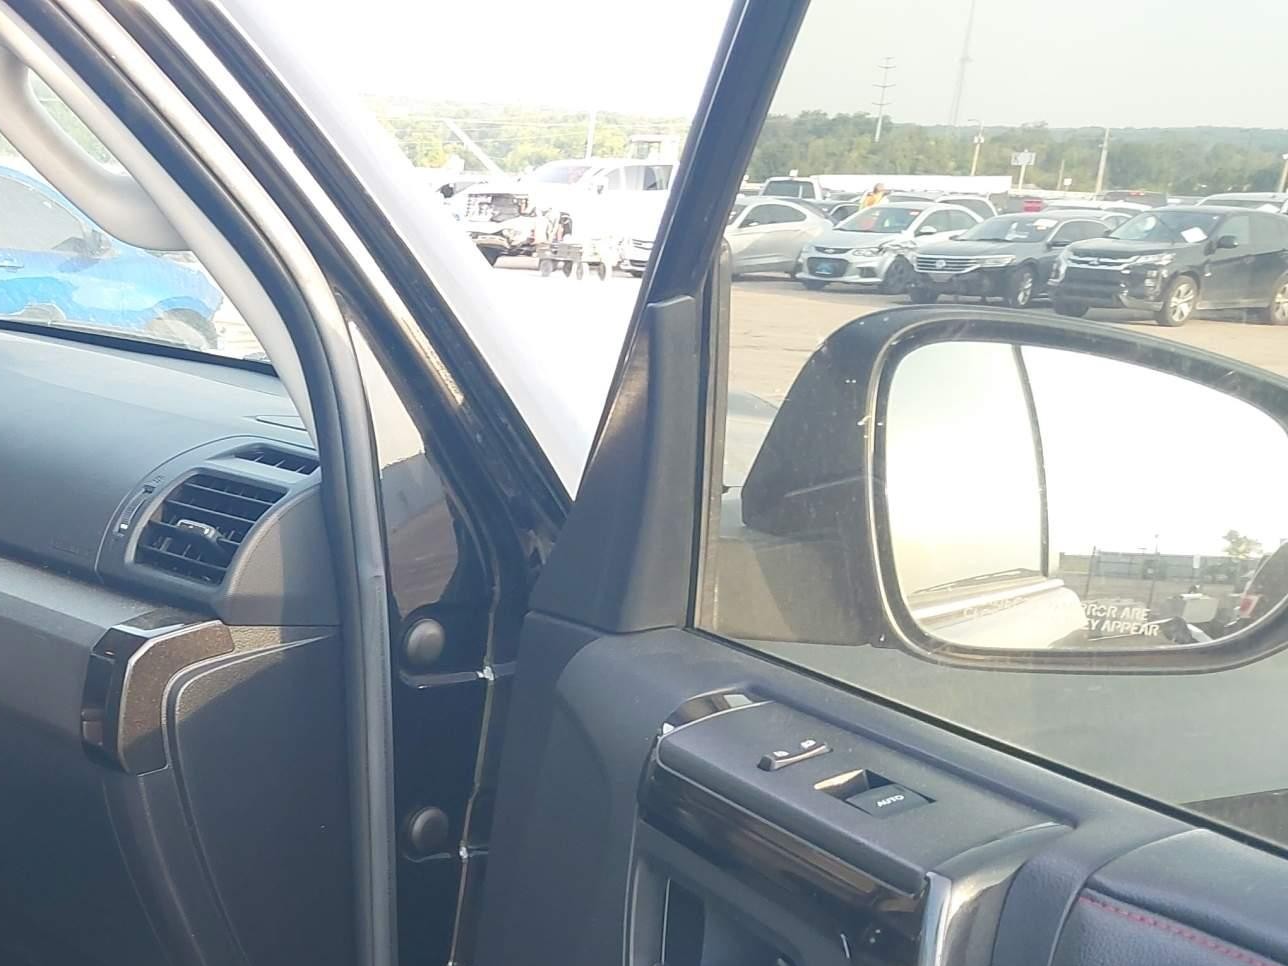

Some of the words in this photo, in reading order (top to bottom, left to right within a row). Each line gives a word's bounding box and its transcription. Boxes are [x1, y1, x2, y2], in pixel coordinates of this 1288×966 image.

[1120, 607, 1151, 621] ARE
[1101, 620, 1159, 637] APPEAR
[877, 794, 905, 807] AUTO
